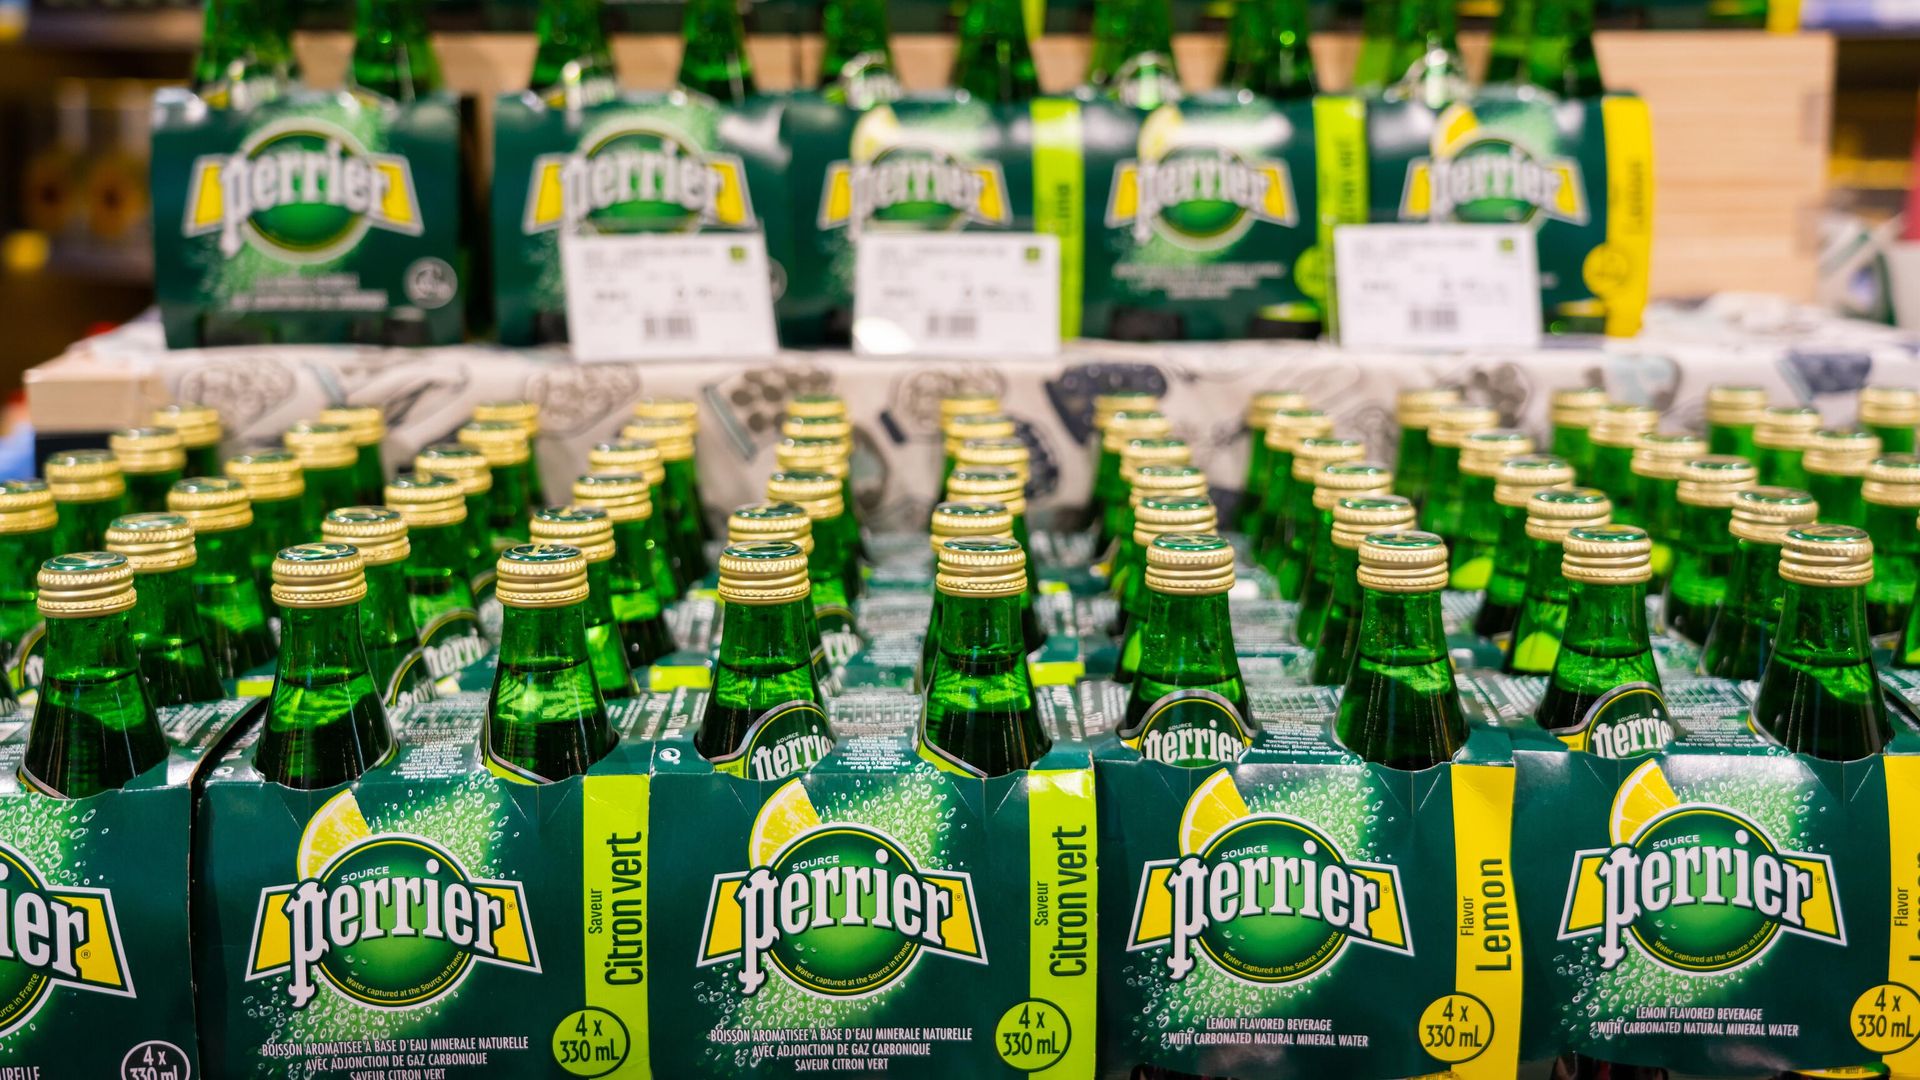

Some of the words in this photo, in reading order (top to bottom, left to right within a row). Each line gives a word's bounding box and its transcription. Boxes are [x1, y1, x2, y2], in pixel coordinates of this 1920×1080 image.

[219, 136, 390, 257] perrier
[561, 138, 724, 232] perrier
[1168, 722, 1193, 732] SOURCE
[1617, 712, 1640, 725] SOURCE
[776, 731, 800, 745] SOURCE
[1221, 844, 1268, 861] SOURCE
[1652, 834, 1700, 850] SOURCE
[606, 831, 642, 894] vert
[792, 854, 840, 872] SOURCE
[1052, 824, 1087, 887] vert
[340, 865, 390, 883] SOURCE
[588, 888, 603, 934] Saveur
[1034, 881, 1048, 926] Saveur
[1167, 840, 1377, 979] perrier
[1597, 829, 1812, 969] perrier
[1894, 888, 1908, 926] Flavor
[737, 848, 950, 994] perrier
[1460, 896, 1474, 936] Flavor
[1475, 858, 1512, 972] Lemon
[286, 858, 502, 1007] perrier
[604, 900, 644, 986] Citron
[1049, 892, 1088, 977] Citron
[1654, 940, 1674, 956] Water
[1674, 951, 1706, 963] captured
[1706, 955, 1713, 963] at
[1714, 952, 1726, 962] the
[1726, 943, 1748, 958] Source
[1748, 936, 1756, 946] in
[1753, 920, 1771, 941] France
[794, 964, 814, 980] Water
[815, 974, 847, 986] captured
[848, 978, 855, 986] at
[856, 975, 868, 984] the
[868, 965, 890, 981] Source
[888, 959, 898, 969] in
[894, 940, 912, 962] France
[1223, 951, 1242, 967] Water
[1242, 962, 1274, 974] captured
[1275, 966, 1282, 974] at
[1283, 963, 1295, 972] the
[1295, 953, 1316, 969] Source
[1316, 947, 1323, 957] in
[1321, 930, 1339, 951] France
[345, 976, 366, 992] Water
[366, 986, 399, 998] captured
[400, 990, 408, 998] at
[408, 986, 420, 996] the
[420, 976, 442, 992] Source
[441, 970, 450, 980] in
[446, 950, 464, 973] France
[0, 1004, 14, 1017] urce
[12, 997, 22, 1006] in
[19, 974, 40, 998] France
[1875, 988, 1886, 1012] 4
[1892, 996, 1900, 1012] x
[1018, 1004, 1030, 1029] 4
[1036, 1011, 1045, 1028] x
[1443, 998, 1454, 1022] 4
[1460, 1006, 1468, 1022] x
[1636, 1006, 1666, 1019] LEMON
[1670, 1008, 1714, 1020] FLAVORED
[1718, 1008, 1762, 1020] BEVERAGE
[576, 1012, 587, 1036] 4
[594, 1020, 603, 1036] x
[710, 1029, 750, 1042] BOISSON
[752, 1028, 809, 1042] AROMATISEE
[820, 1028, 842, 1040] BASE
[845, 1028, 873, 1040] D'EAU
[876, 1028, 920, 1040] MINERALE
[923, 1028, 972, 1040] NATURELLE
[1206, 1018, 1236, 1030] LEMON
[1240, 1018, 1284, 1030] FLAVORED
[1288, 1019, 1332, 1031] BEVERAGE
[1426, 1024, 1455, 1047] 330
[1459, 1024, 1482, 1047] mL
[1598, 1022, 1620, 1034] WITH
[1624, 1022, 1680, 1034] CARBONATED
[1684, 1023, 1724, 1034] NATURAL
[1726, 1024, 1766, 1036] MINERAL
[1768, 1024, 1798, 1036] WATER
[1856, 1014, 1887, 1038] 330
[1891, 1015, 1914, 1038] mL
[262, 1044, 302, 1056] BOISSON
[305, 1041, 362, 1055] AROMATISEE
[375, 1040, 397, 1052] BASE
[400, 1038, 428, 1051] D'EAU
[430, 1038, 476, 1050] MINERALE
[478, 1036, 528, 1050] NATURELLE
[560, 1038, 590, 1064] 330
[596, 1038, 620, 1062] mL
[752, 1044, 774, 1058] AVEC
[778, 1044, 834, 1056] ADJONCTION
[837, 1044, 850, 1056] DE
[852, 1044, 870, 1056] GAZ
[872, 1043, 931, 1056] CARBONIQUE
[1002, 1032, 1032, 1056] 330
[1037, 1030, 1060, 1054] mL
[1168, 1032, 1191, 1044] WITH
[1194, 1032, 1250, 1044] CARBONATED
[1254, 1034, 1294, 1045] NATURAL
[1296, 1034, 1336, 1046] MINERAL
[1338, 1035, 1368, 1046] WATER
[143, 1046, 154, 1066] 4
[158, 1051, 167, 1065] x
[306, 1058, 328, 1072] AVEC
[331, 1056, 389, 1070] ADJONCTION
[392, 1054, 405, 1067] DE
[407, 1054, 425, 1066] GAZ
[428, 1052, 488, 1066] CARBONIQUE
[794, 1059, 830, 1071] SAVEUR
[832, 1058, 864, 1070] CITRON
[867, 1058, 888, 1070] VERT
[350, 1070, 386, 1080] SAVEUR
[388, 1068, 422, 1080] CITRON
[424, 1068, 446, 1080] VERT
